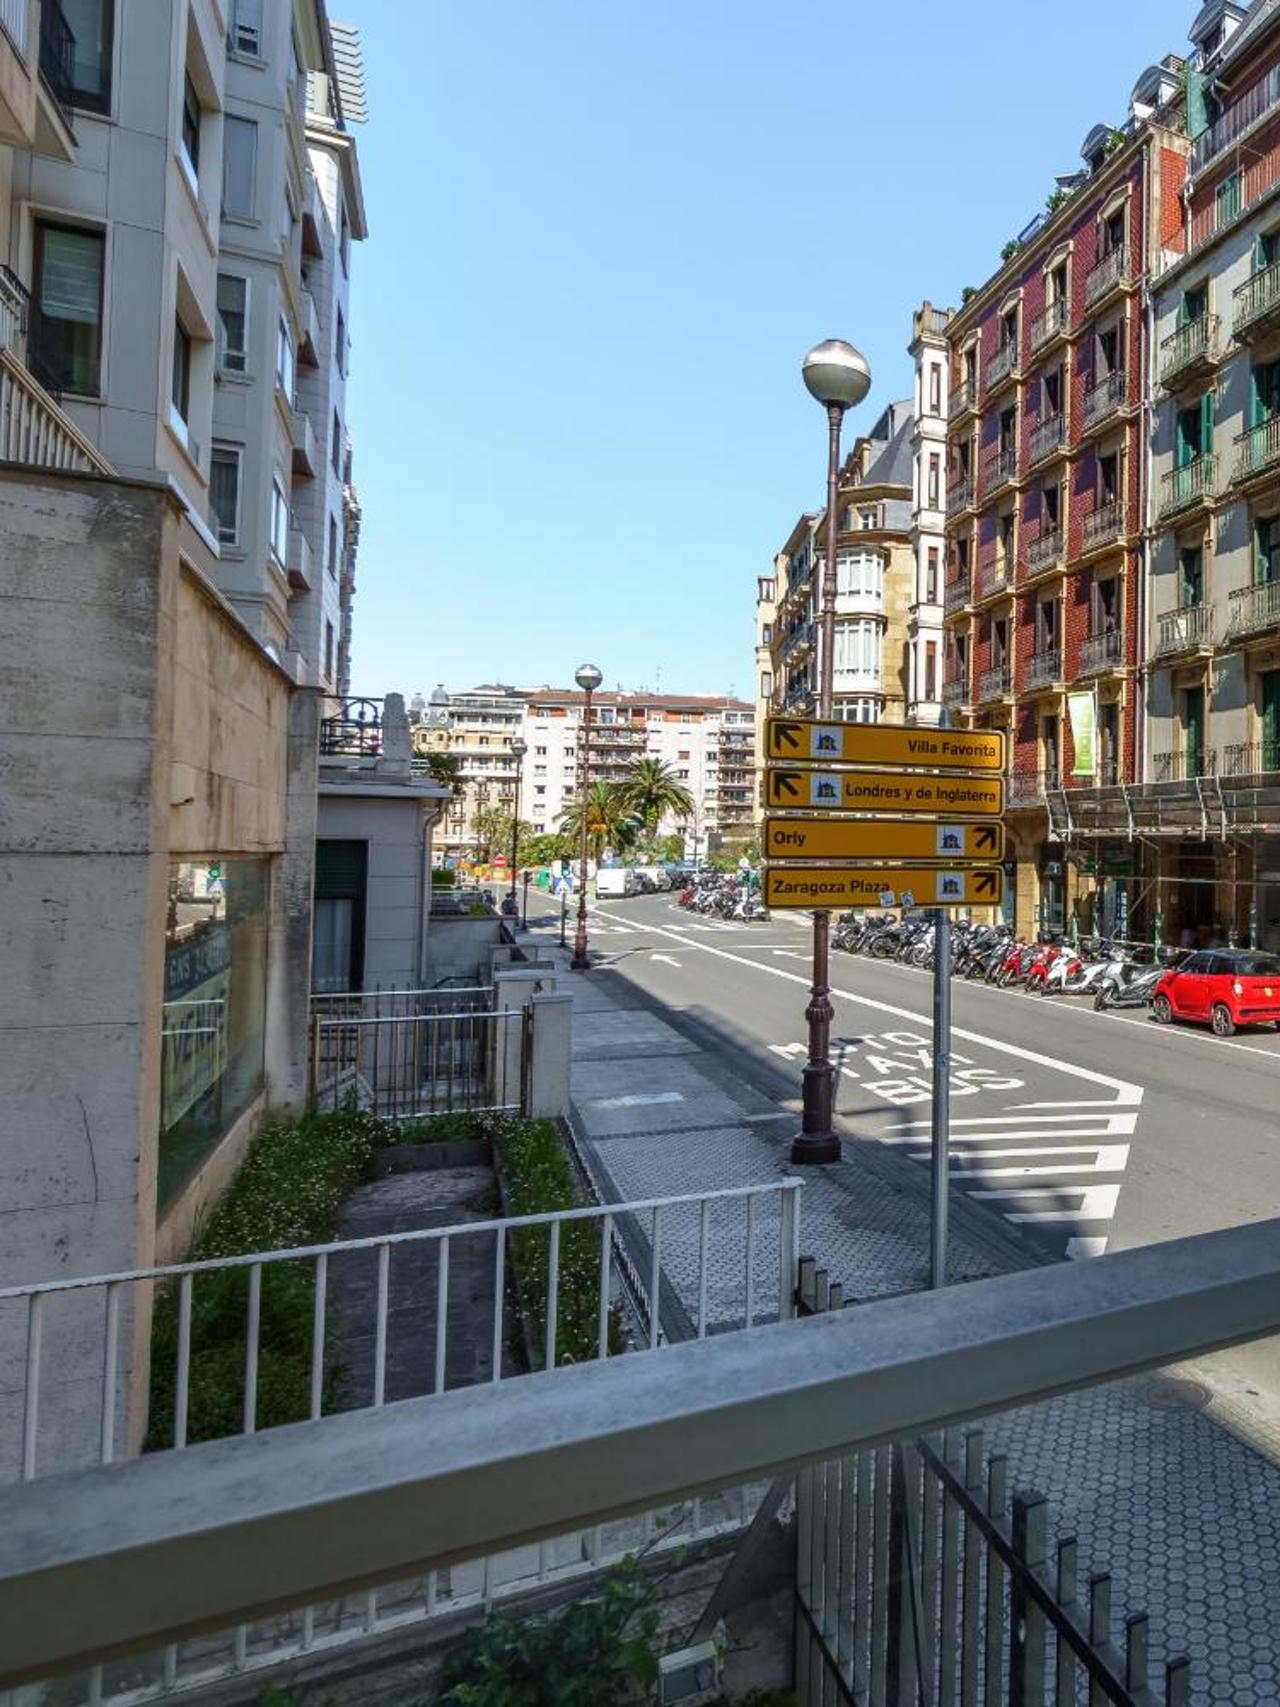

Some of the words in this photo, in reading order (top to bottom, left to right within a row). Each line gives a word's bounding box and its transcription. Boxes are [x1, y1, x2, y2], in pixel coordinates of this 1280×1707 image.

[908, 739, 938, 754] Villa
[941, 741, 996, 757] Favorita
[846, 783, 901, 798] Londres
[903, 787, 912, 800] y
[916, 785, 931, 799] de
[936, 784, 996, 804] Inglaterra
[773, 830, 806, 847] Orly
[773, 879, 845, 896] Zaragoza
[850, 879, 890, 893] Plaza
[860, 1068, 1025, 1105] BUS
